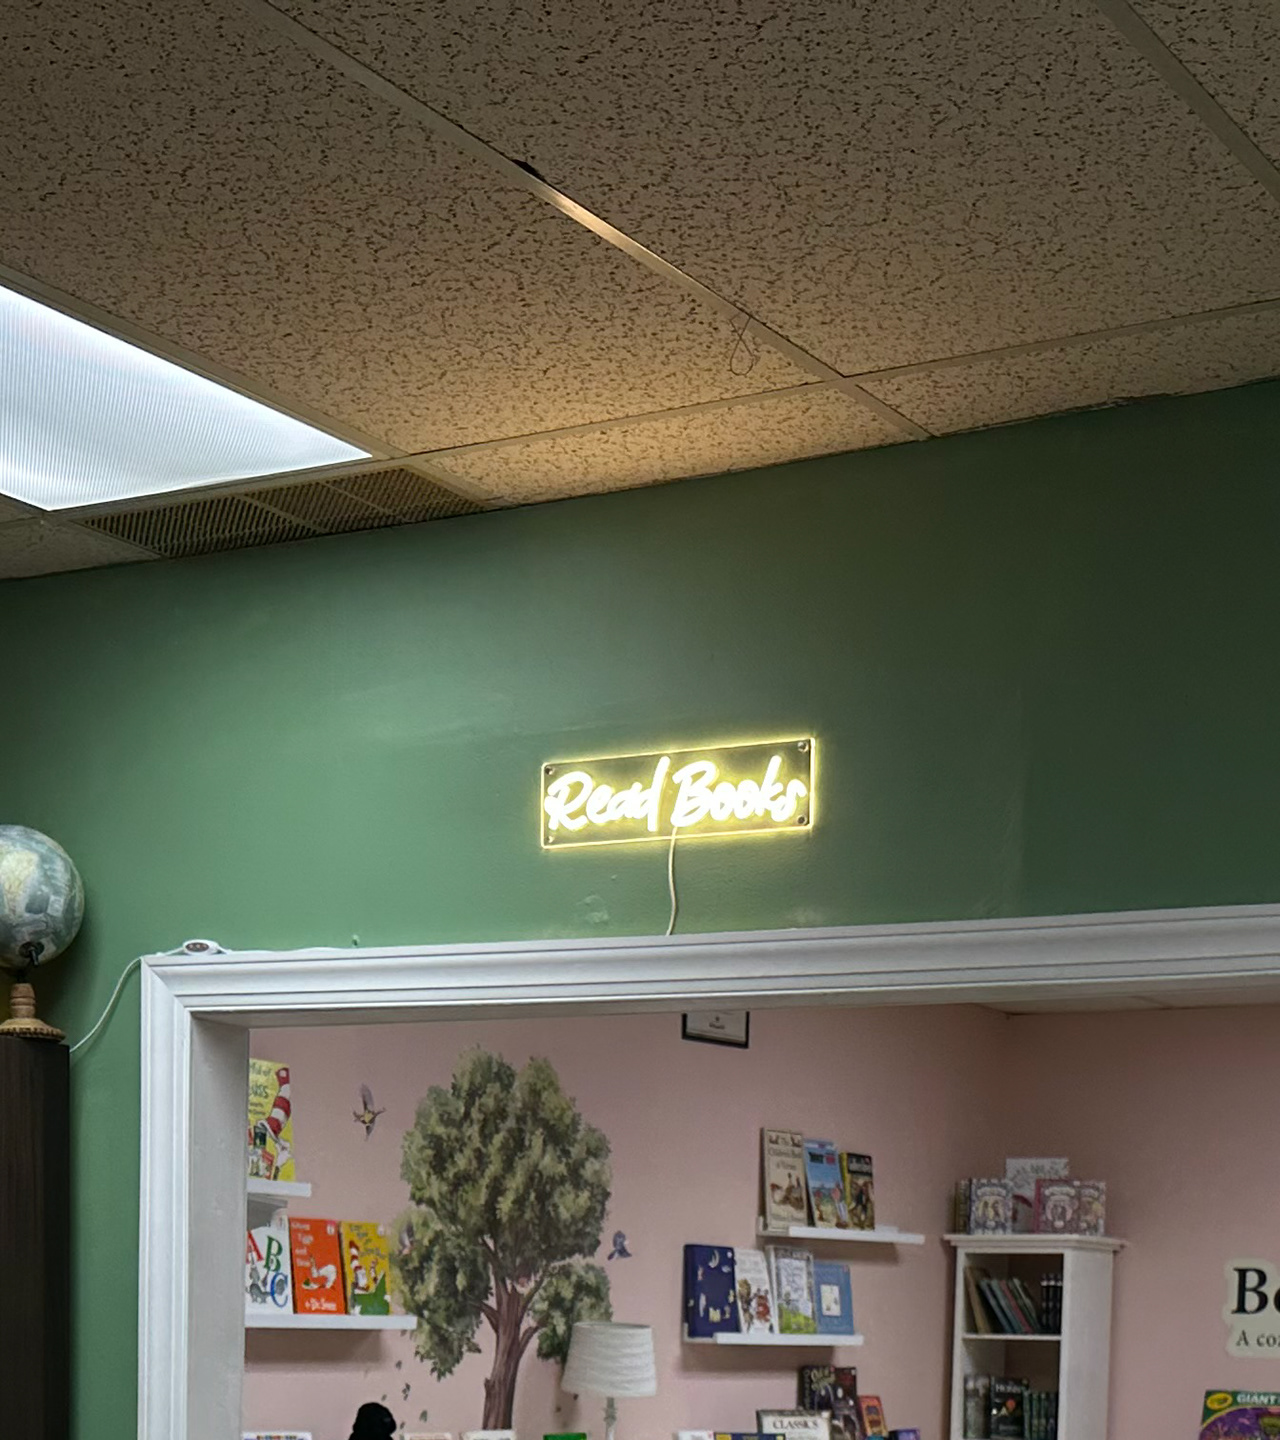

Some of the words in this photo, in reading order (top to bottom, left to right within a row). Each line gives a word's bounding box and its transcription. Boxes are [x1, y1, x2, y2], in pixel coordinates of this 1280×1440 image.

[544, 756, 670, 832] Read
[670, 755, 807, 827] Books
[1236, 1330, 1249, 1346] A
[1236, 1393, 1276, 1405] GIANT
[772, 1419, 819, 1431] CLASSICS
